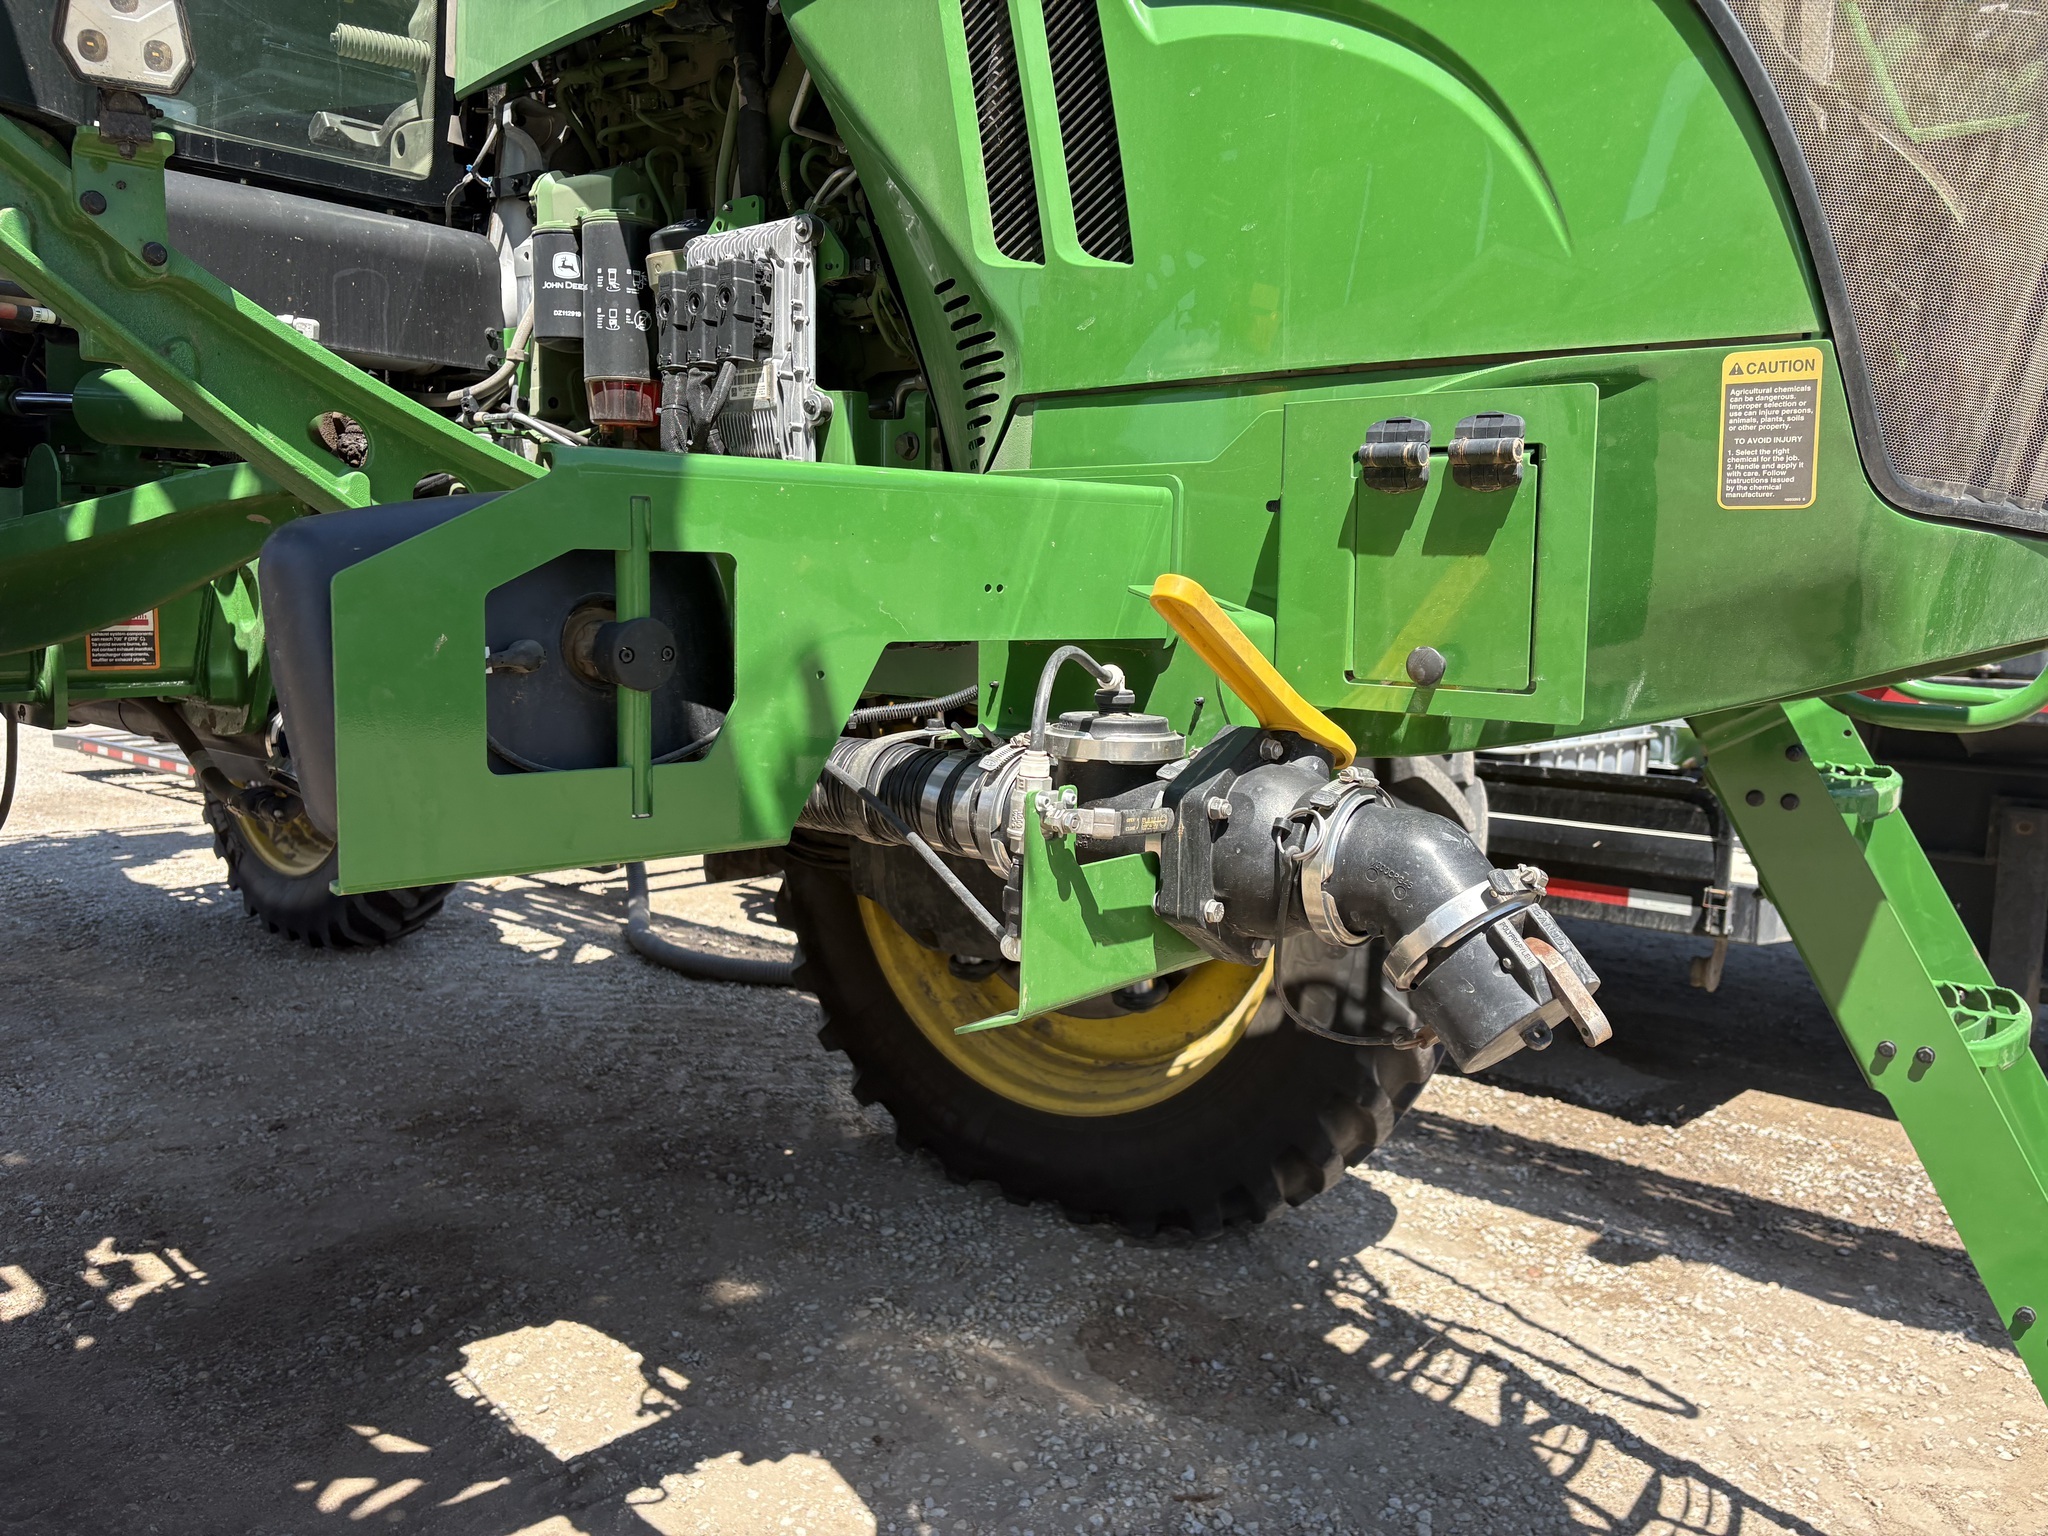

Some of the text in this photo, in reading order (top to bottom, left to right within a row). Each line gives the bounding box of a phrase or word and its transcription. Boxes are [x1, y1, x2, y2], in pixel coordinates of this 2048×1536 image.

[542, 281, 564, 289] JOHN
[1746, 359, 1815, 374] CAUTION
[1730, 385, 1811, 396] Agricultural chemicals
[1755, 394, 1796, 402] dangerous.
[1758, 409, 1780, 417] injure
[1781, 408, 1814, 416] persons,
[1760, 416, 1785, 424] plants,
[1758, 423, 1792, 431] property.
[1772, 448, 1790, 456] right
[1785, 455, 1800, 463] job.
[1776, 462, 1797, 470] apply
[1725, 484, 1735, 492] by
[1499, 922, 1537, 966] POLYPROPYLENE
